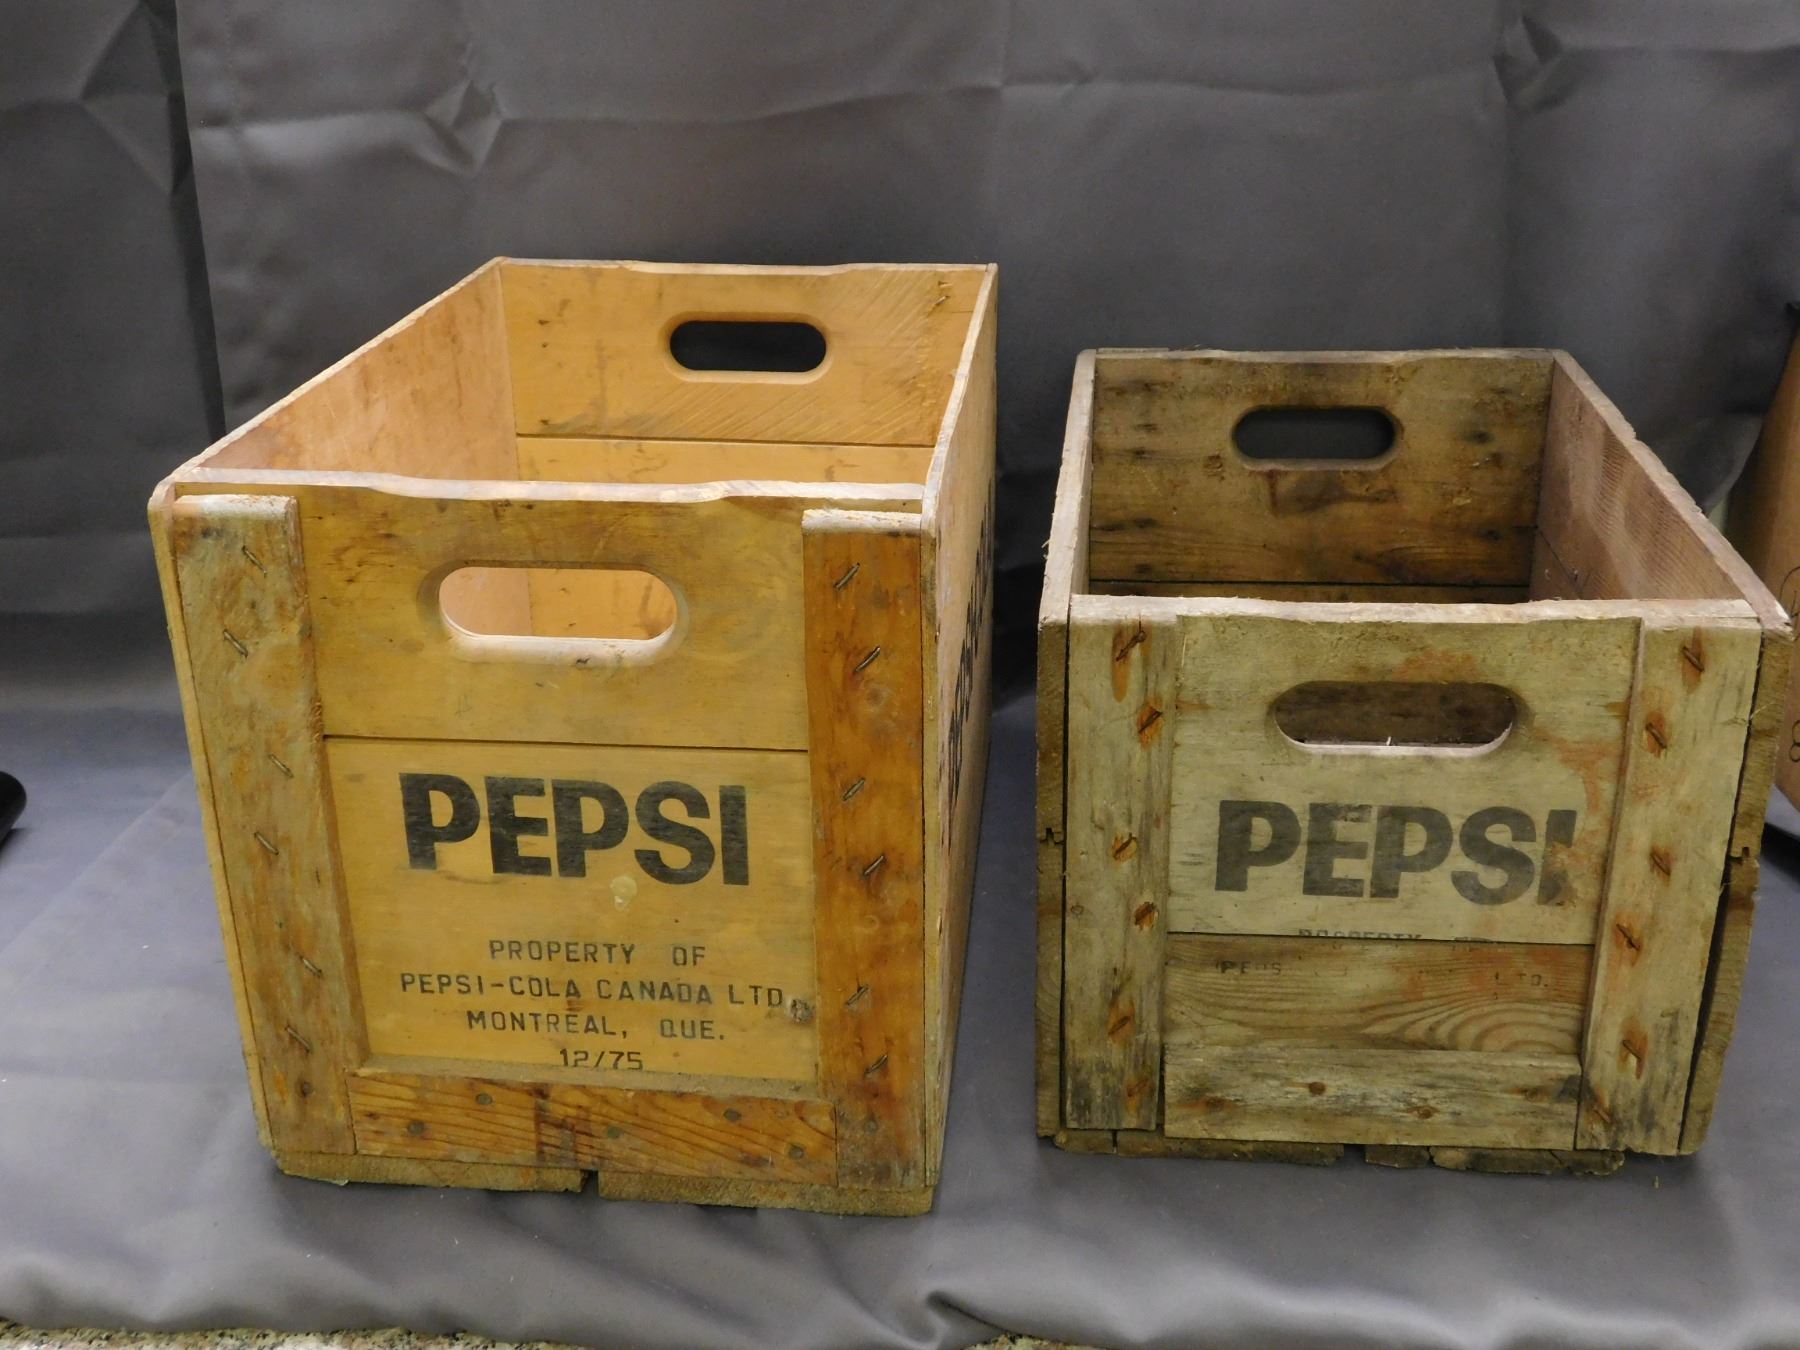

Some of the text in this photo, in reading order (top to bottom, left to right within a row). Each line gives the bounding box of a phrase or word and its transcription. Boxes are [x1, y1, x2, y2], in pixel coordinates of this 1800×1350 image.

[399, 773, 749, 886] PEPSI
[1214, 800, 1577, 906] PEPSI
[489, 940, 706, 967] PROPERTY OF
[401, 973, 580, 999] PEPSI-COLA
[597, 979, 712, 1005] CANADA
[467, 1010, 724, 1040] MONTREAL, QUE.
[559, 1048, 643, 1071] 12/75
